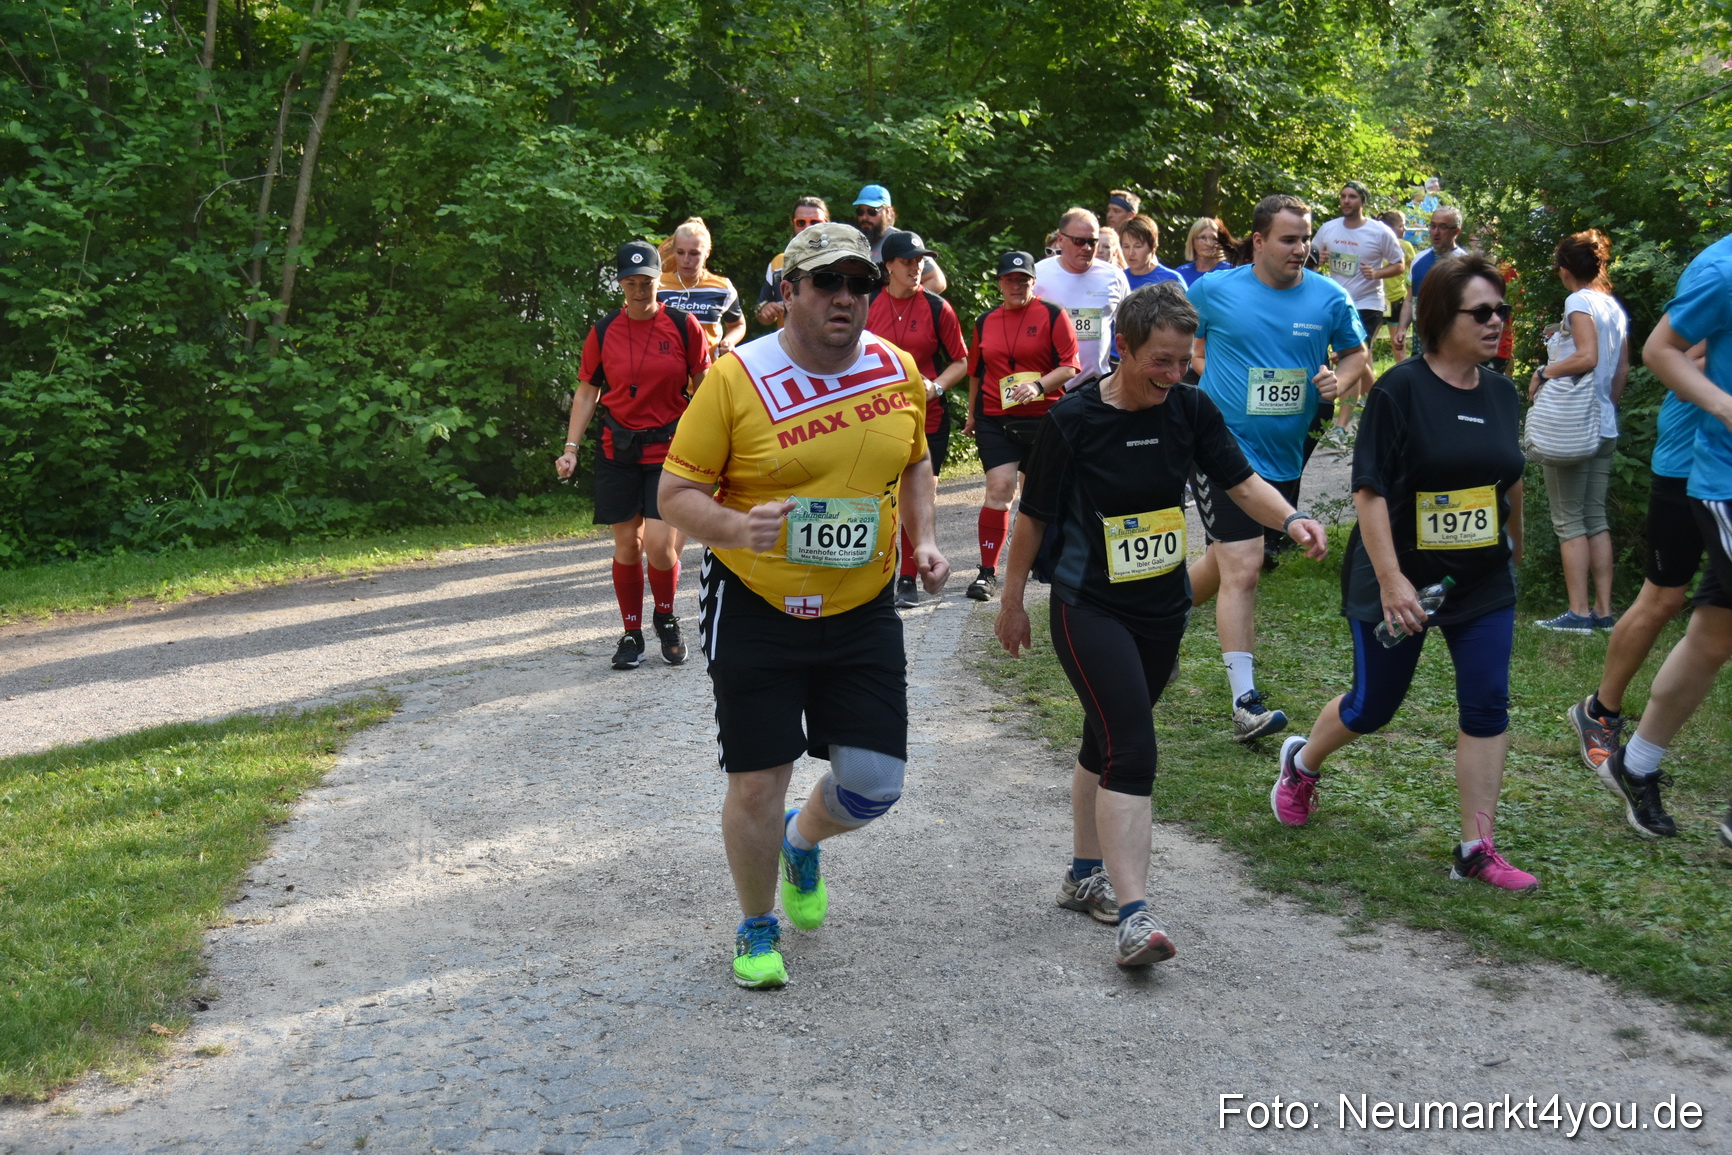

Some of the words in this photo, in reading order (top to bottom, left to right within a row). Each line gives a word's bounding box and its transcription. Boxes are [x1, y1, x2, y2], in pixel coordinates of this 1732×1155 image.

[1333, 260, 1352, 270] 1191
[671, 302, 712, 310] Fischer
[658, 341, 670, 350] 10
[1256, 384, 1300, 402] 1859
[776, 411, 850, 449] MAX
[854, 392, 912, 422] BÖGL
[1428, 509, 1488, 534] 1978
[800, 523, 868, 548] 1602
[798, 548, 836, 556] Inzenhofer
[1118, 532, 1176, 562] 1970
[1152, 558, 1164, 566] Gabi
